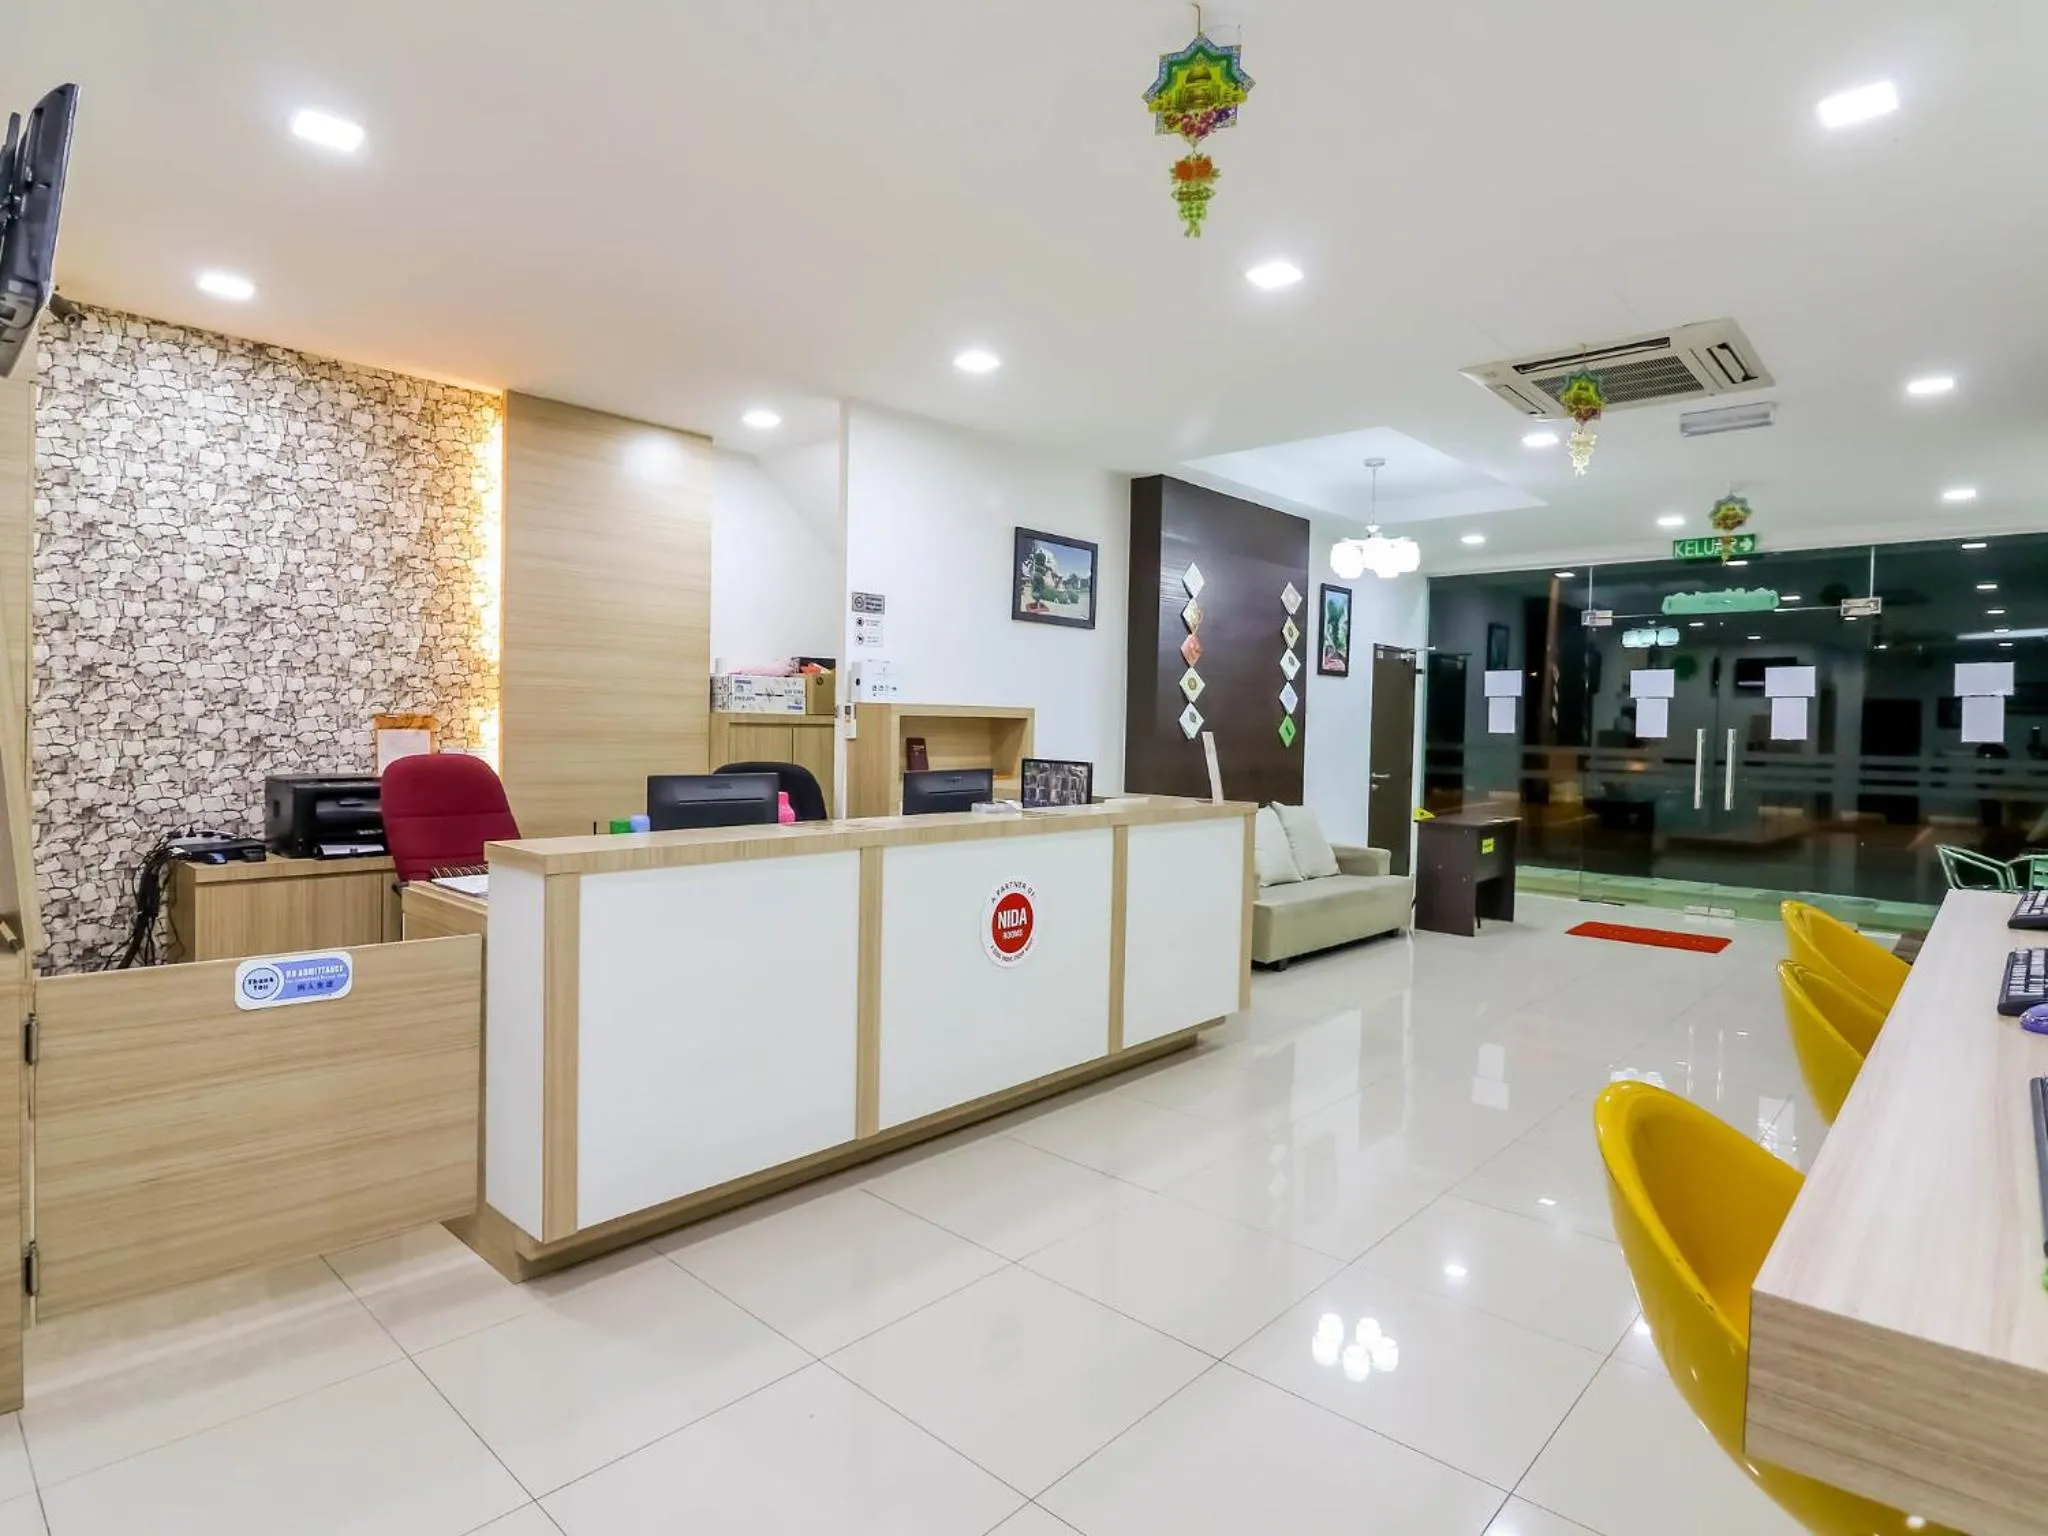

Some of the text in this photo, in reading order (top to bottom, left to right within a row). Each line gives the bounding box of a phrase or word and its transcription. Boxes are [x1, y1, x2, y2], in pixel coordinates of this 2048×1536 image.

[996, 880, 1027, 896] PARTNER
[997, 907, 1028, 930] NIDA
[1002, 928, 1024, 940] ROOMS
[298, 964, 344, 977] ADMITTANCE
